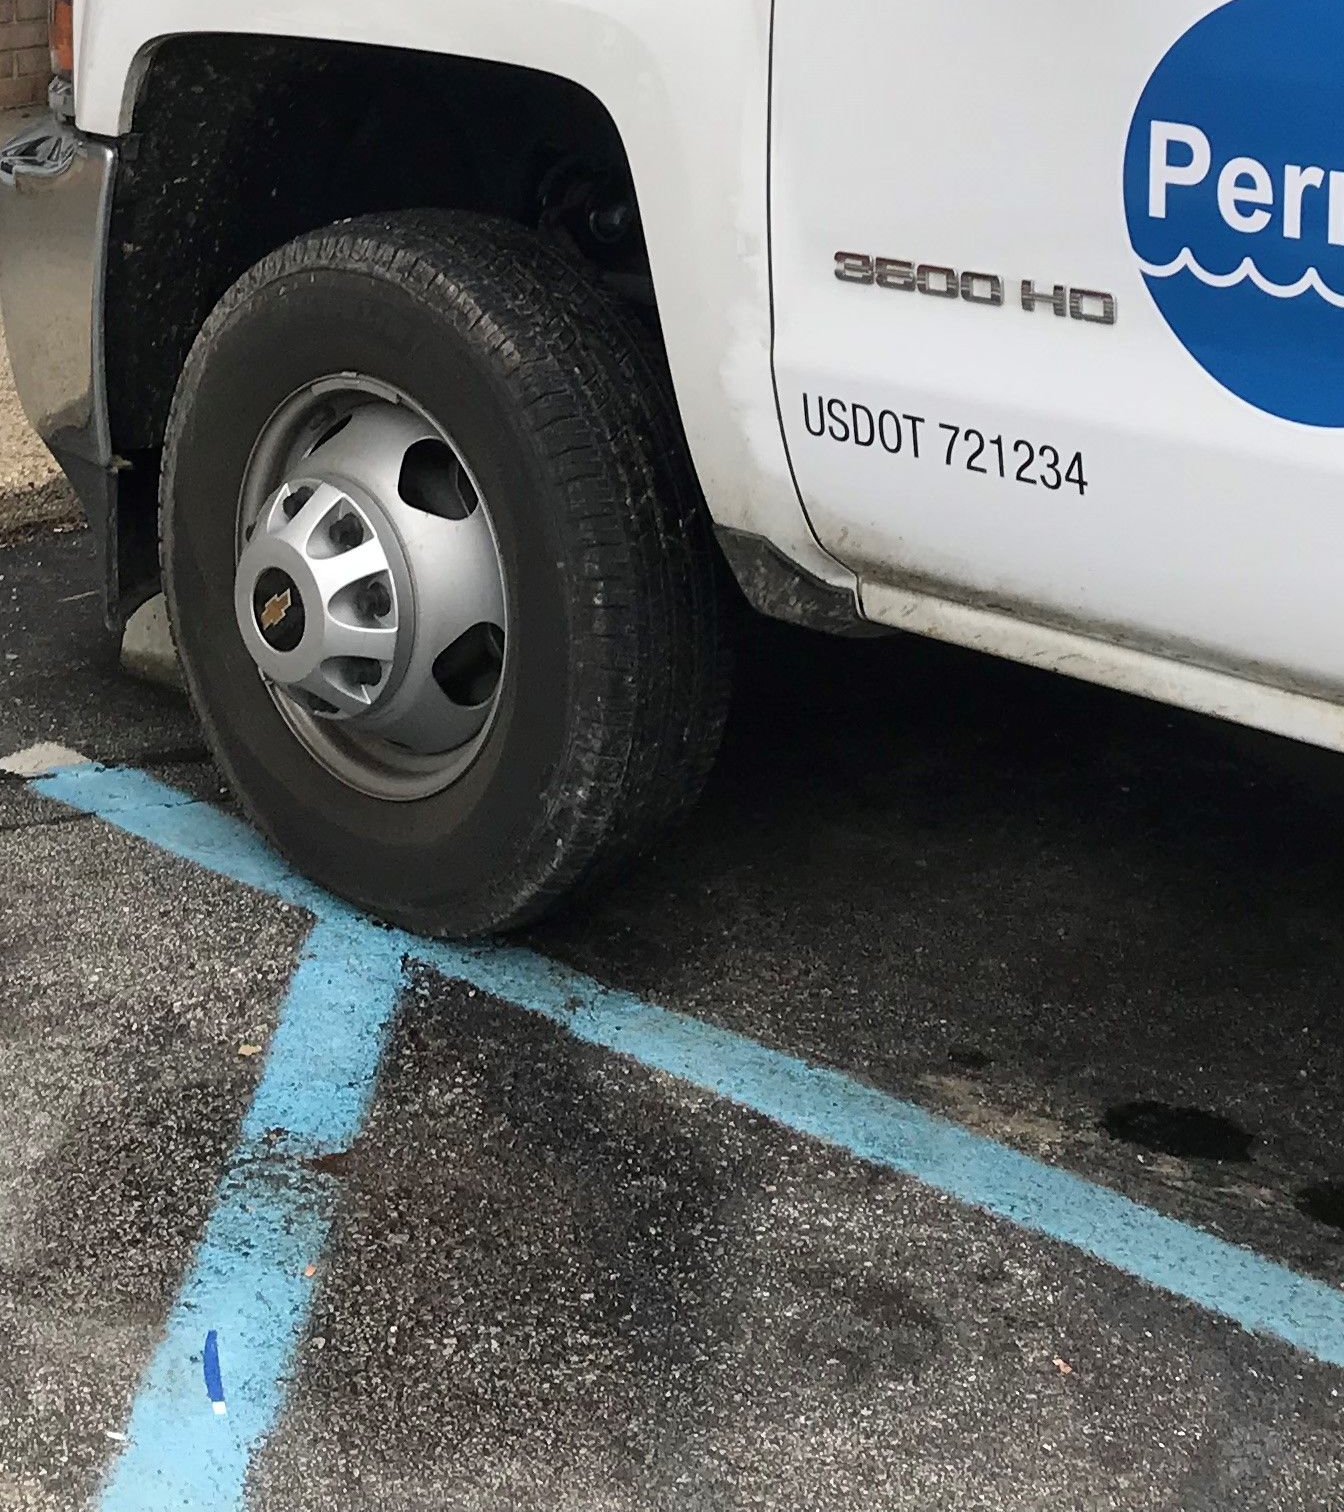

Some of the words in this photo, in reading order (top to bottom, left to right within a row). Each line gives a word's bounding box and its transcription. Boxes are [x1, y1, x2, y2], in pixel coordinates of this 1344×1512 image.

[834, 251, 1004, 306] 3500
[1021, 279, 1117, 325] HD
[803, 392, 925, 458] USDOT
[938, 422, 1088, 495] 721234
